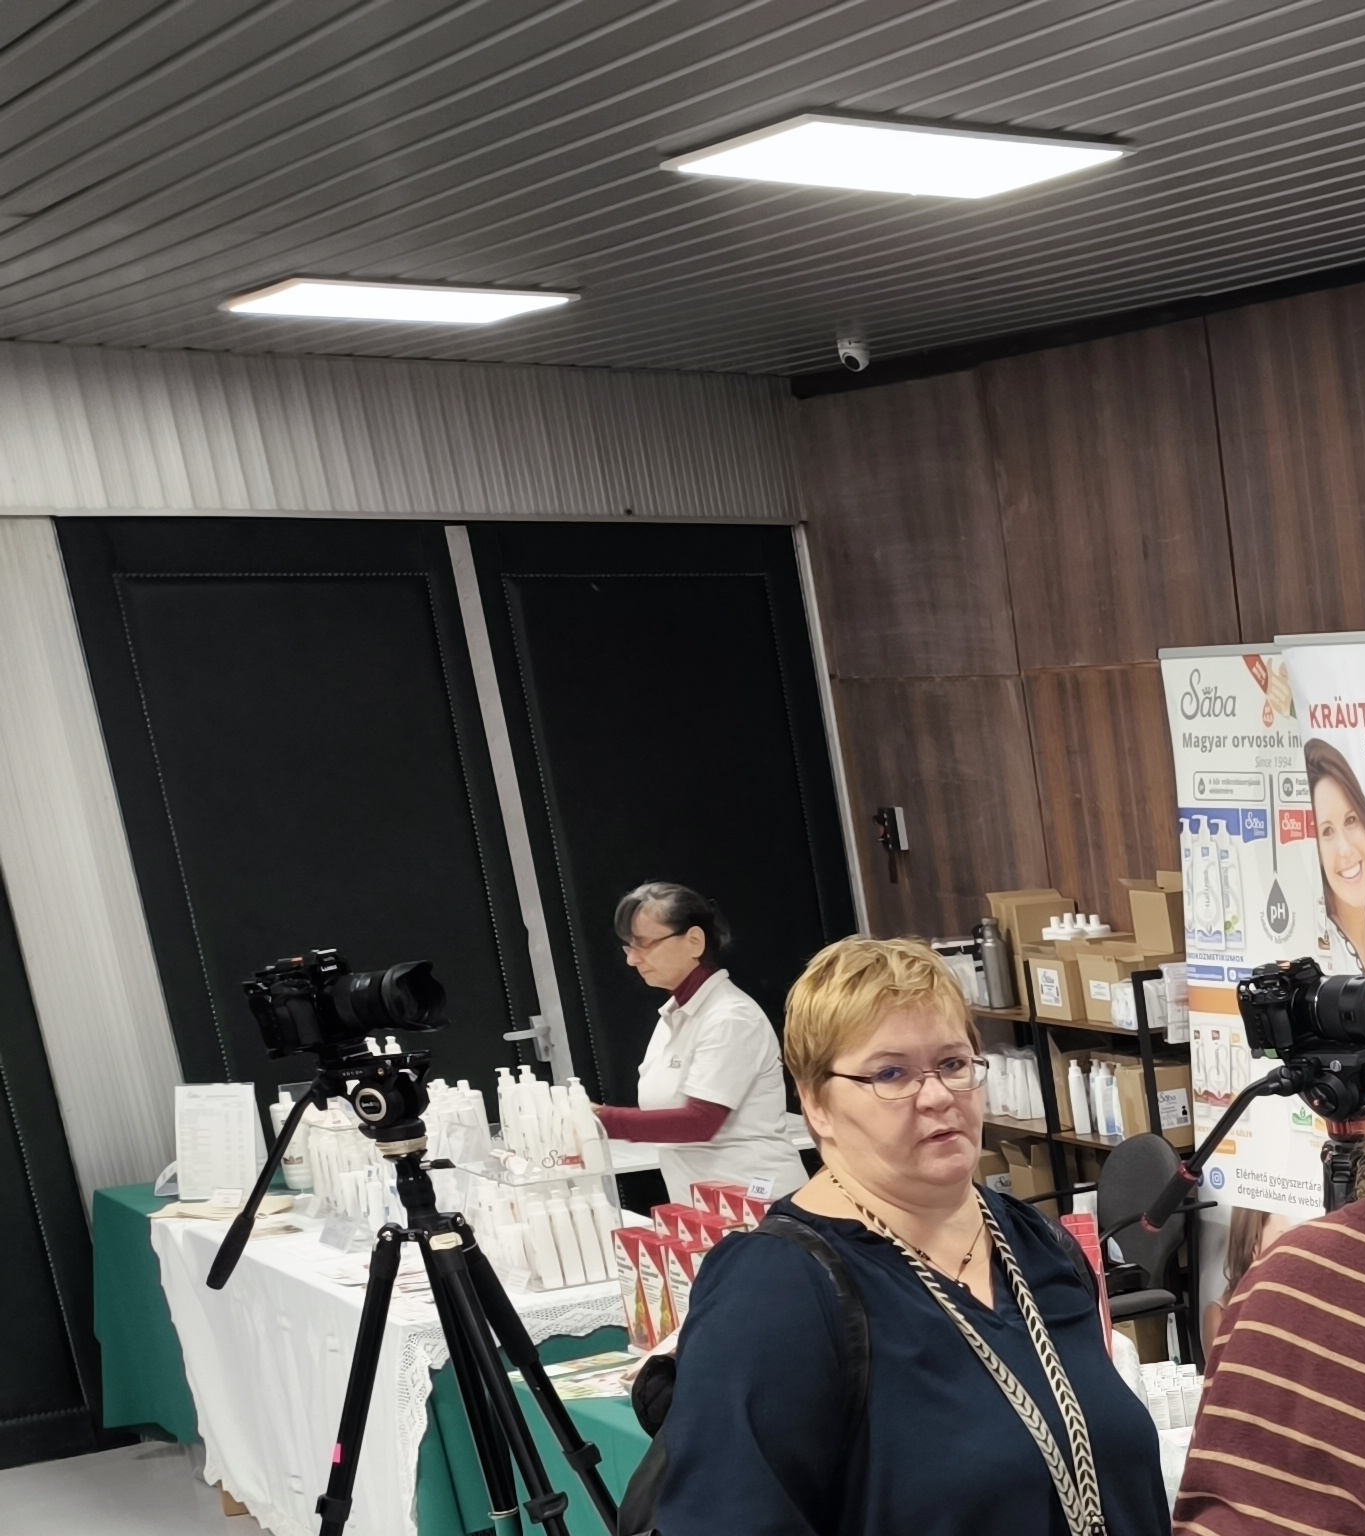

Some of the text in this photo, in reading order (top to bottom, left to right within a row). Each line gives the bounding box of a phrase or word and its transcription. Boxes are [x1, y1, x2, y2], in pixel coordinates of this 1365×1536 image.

[1182, 732, 1228, 753] Magyar
[1232, 731, 1284, 749] orvosok
[1270, 903, 1286, 923] pH
[1236, 1168, 1267, 1182] Elérhető
[1237, 1184, 1286, 1202] drogériákban
[1288, 1193, 1297, 1204] és
